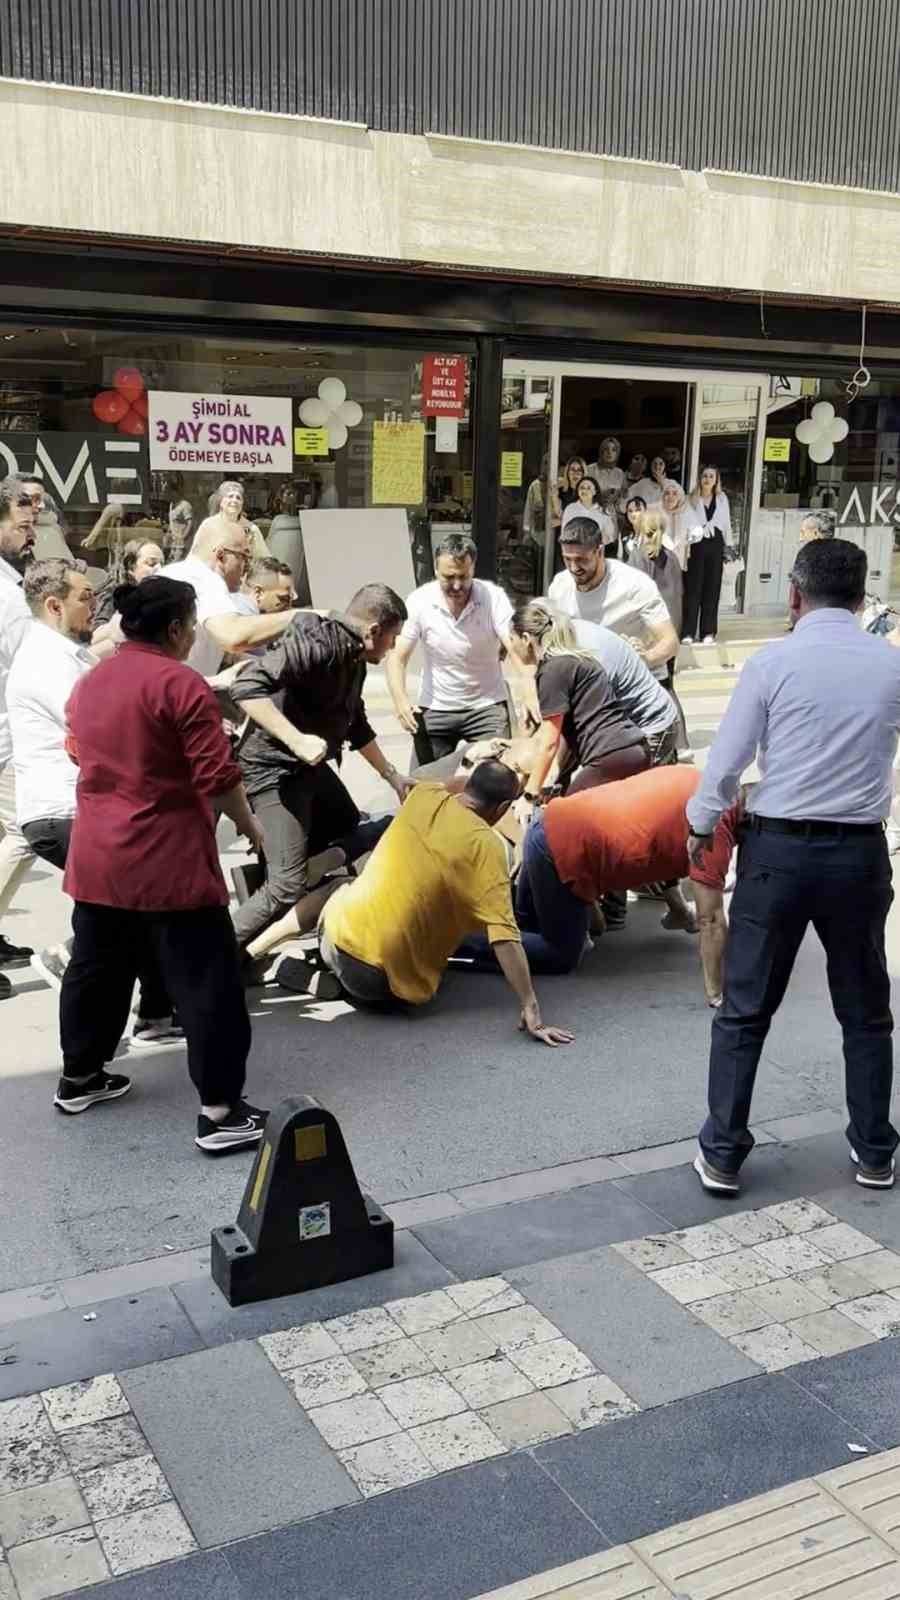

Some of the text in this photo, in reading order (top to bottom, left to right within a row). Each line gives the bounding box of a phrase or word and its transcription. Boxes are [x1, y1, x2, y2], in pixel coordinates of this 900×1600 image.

[192, 398, 251, 419] ŞİMDİ AL
[156, 420, 169, 443] 3
[174, 422, 204, 443] AY
[208, 423, 286, 447] SONRA
[168, 446, 273, 467] ÖDEMEYE BAŞLA
[0, 437, 143, 504] ME
